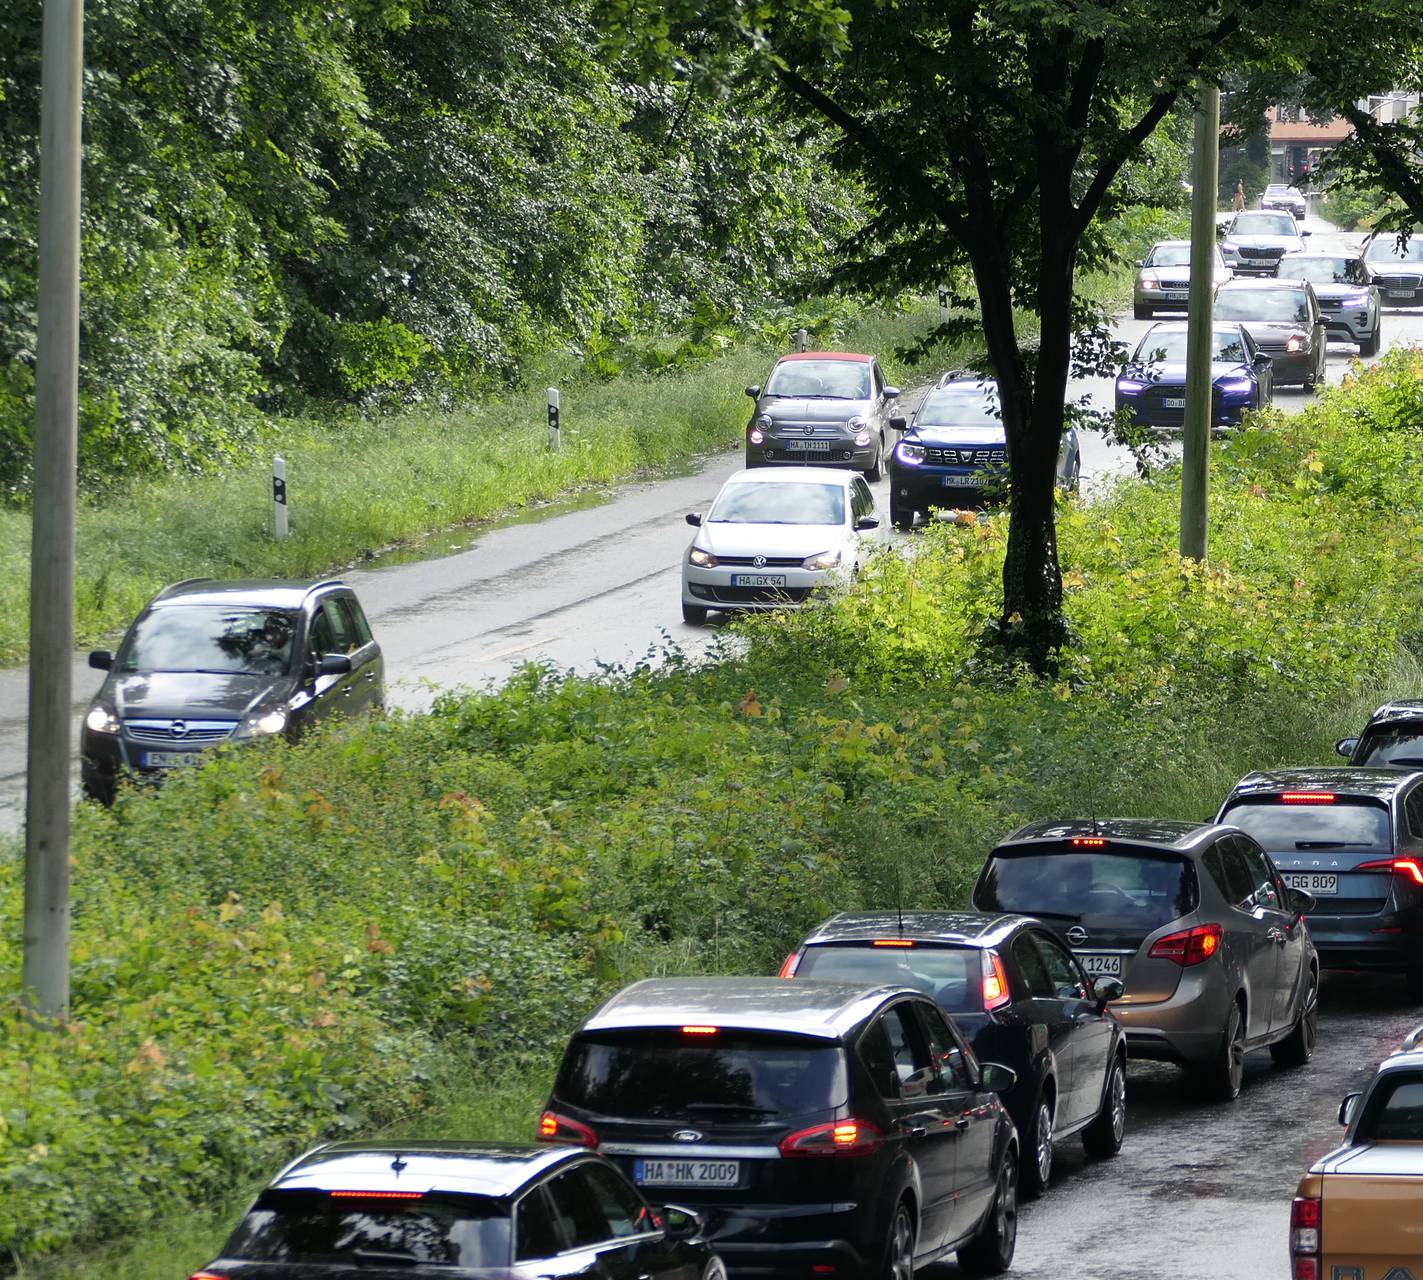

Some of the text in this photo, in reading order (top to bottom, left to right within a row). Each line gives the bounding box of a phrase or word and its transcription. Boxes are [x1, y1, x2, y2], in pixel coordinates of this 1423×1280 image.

[739, 576, 751, 585] HA
[756, 576, 768, 586] GX
[1292, 876, 1336, 889] GG 809
[1087, 958, 1119, 972] 1246
[644, 1163, 737, 1181] HA HK 2009
